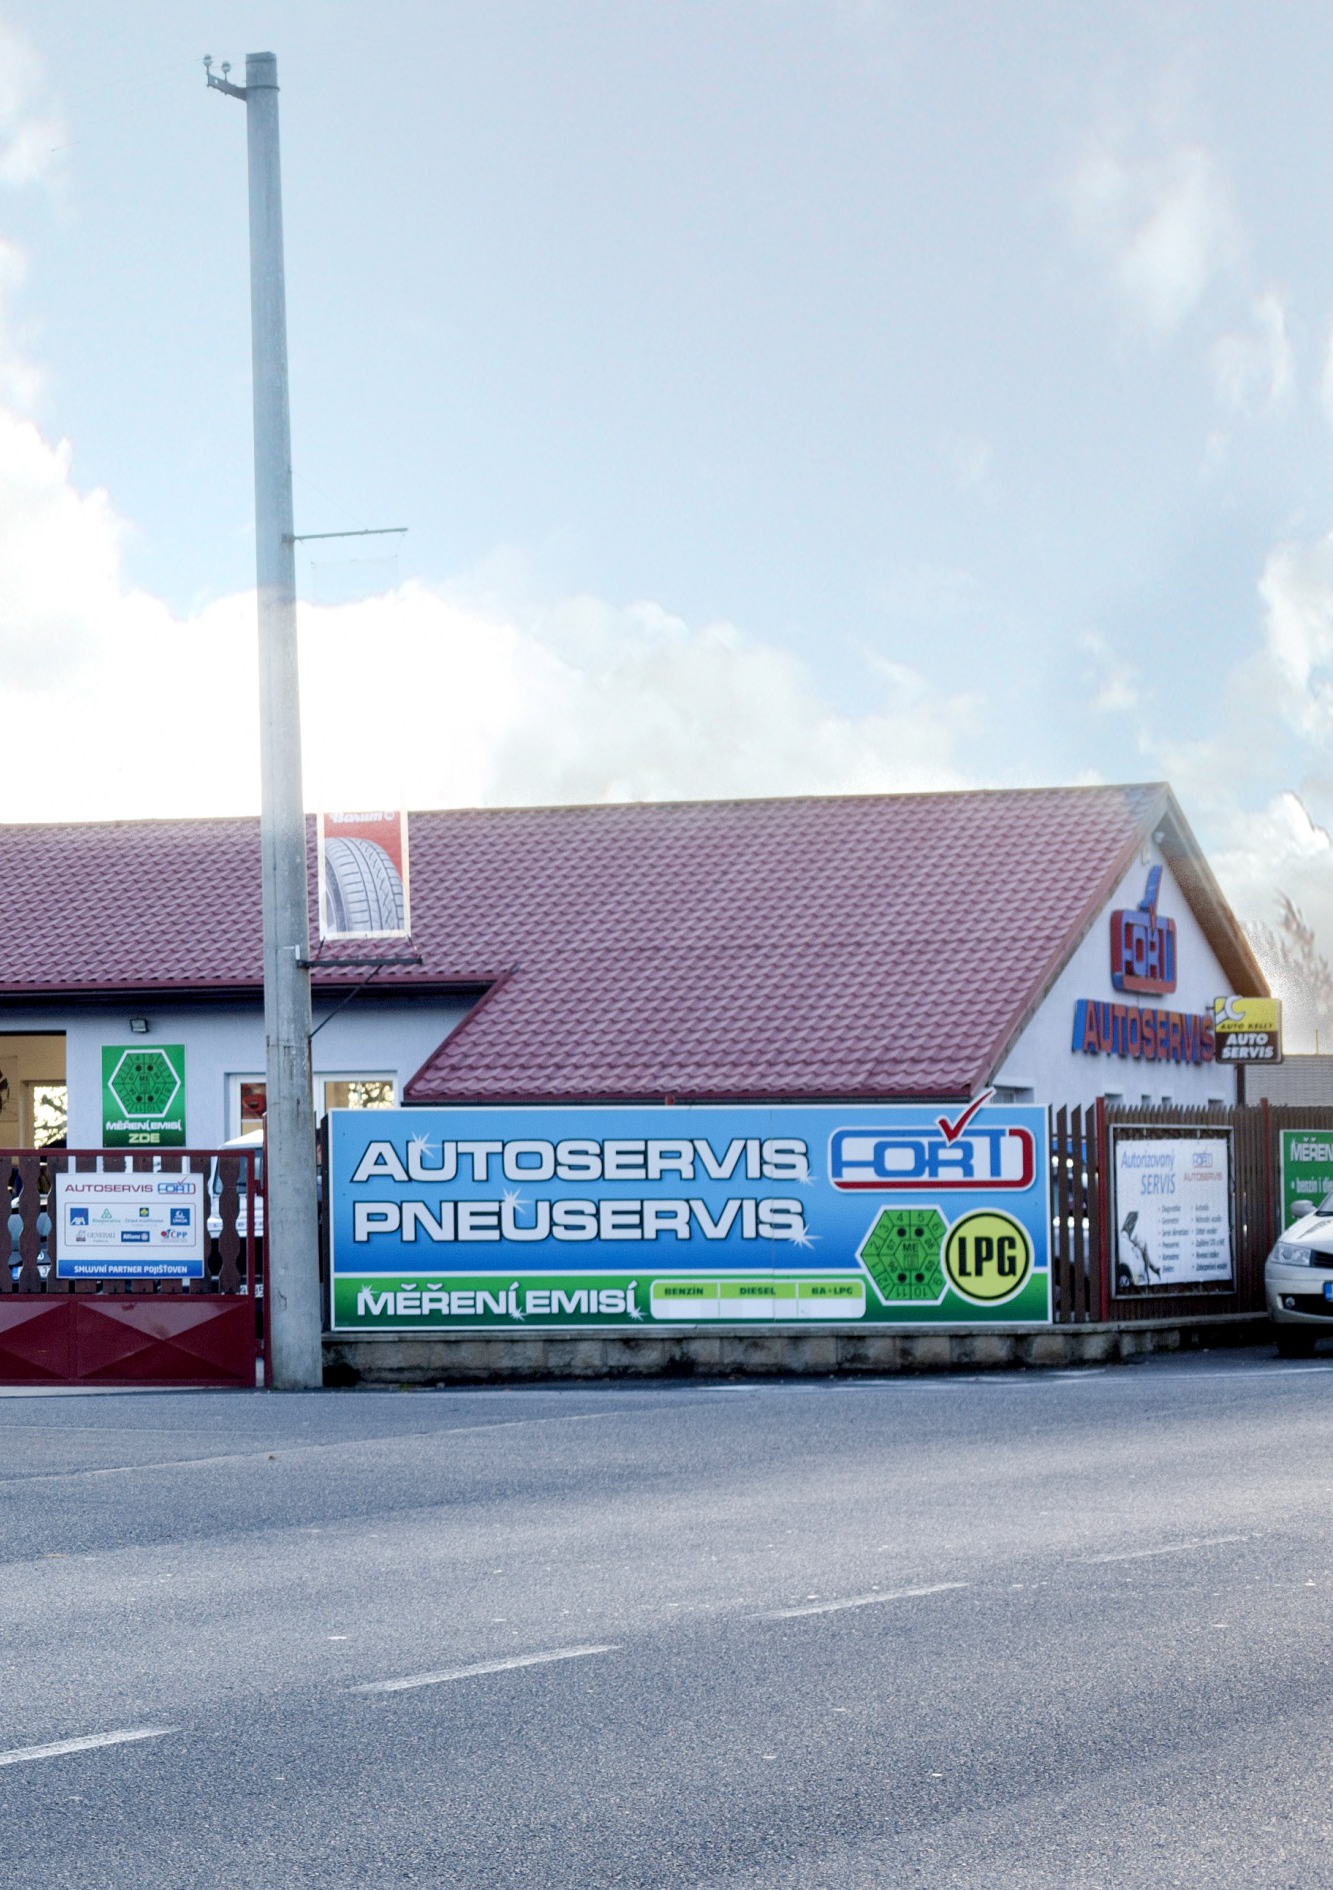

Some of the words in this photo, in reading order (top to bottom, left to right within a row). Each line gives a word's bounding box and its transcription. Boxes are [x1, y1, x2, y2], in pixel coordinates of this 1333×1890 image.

[1076, 999, 1215, 1063] AUTOSERVIS
[1227, 1033, 1269, 1045] AUTO
[1221, 1046, 1273, 1058] SERVIS
[129, 1133, 160, 1143] ZDE
[351, 1138, 809, 1183] AUTOSERVIS
[831, 1127, 1023, 1187] FORT
[65, 1184, 153, 1192] AUTOSERVIS
[158, 1183, 193, 1194] FORT
[1141, 1173, 1175, 1195] SERVIS
[1297, 1176, 1318, 1193] benzín
[352, 1198, 807, 1243] PNEUSERVIS
[171, 1229, 187, 1238] ČPP
[958, 1236, 1017, 1277] LPG
[74, 1264, 107, 1273] SMLUVNÍ
[144, 1264, 187, 1274] POJIŠŤOVEN
[664, 1285, 703, 1295] BENZÍN
[739, 1287, 776, 1295] DIESEL
[357, 1281, 523, 1318] MĚŘENÍ
[525, 1280, 637, 1317] EMISÍ
